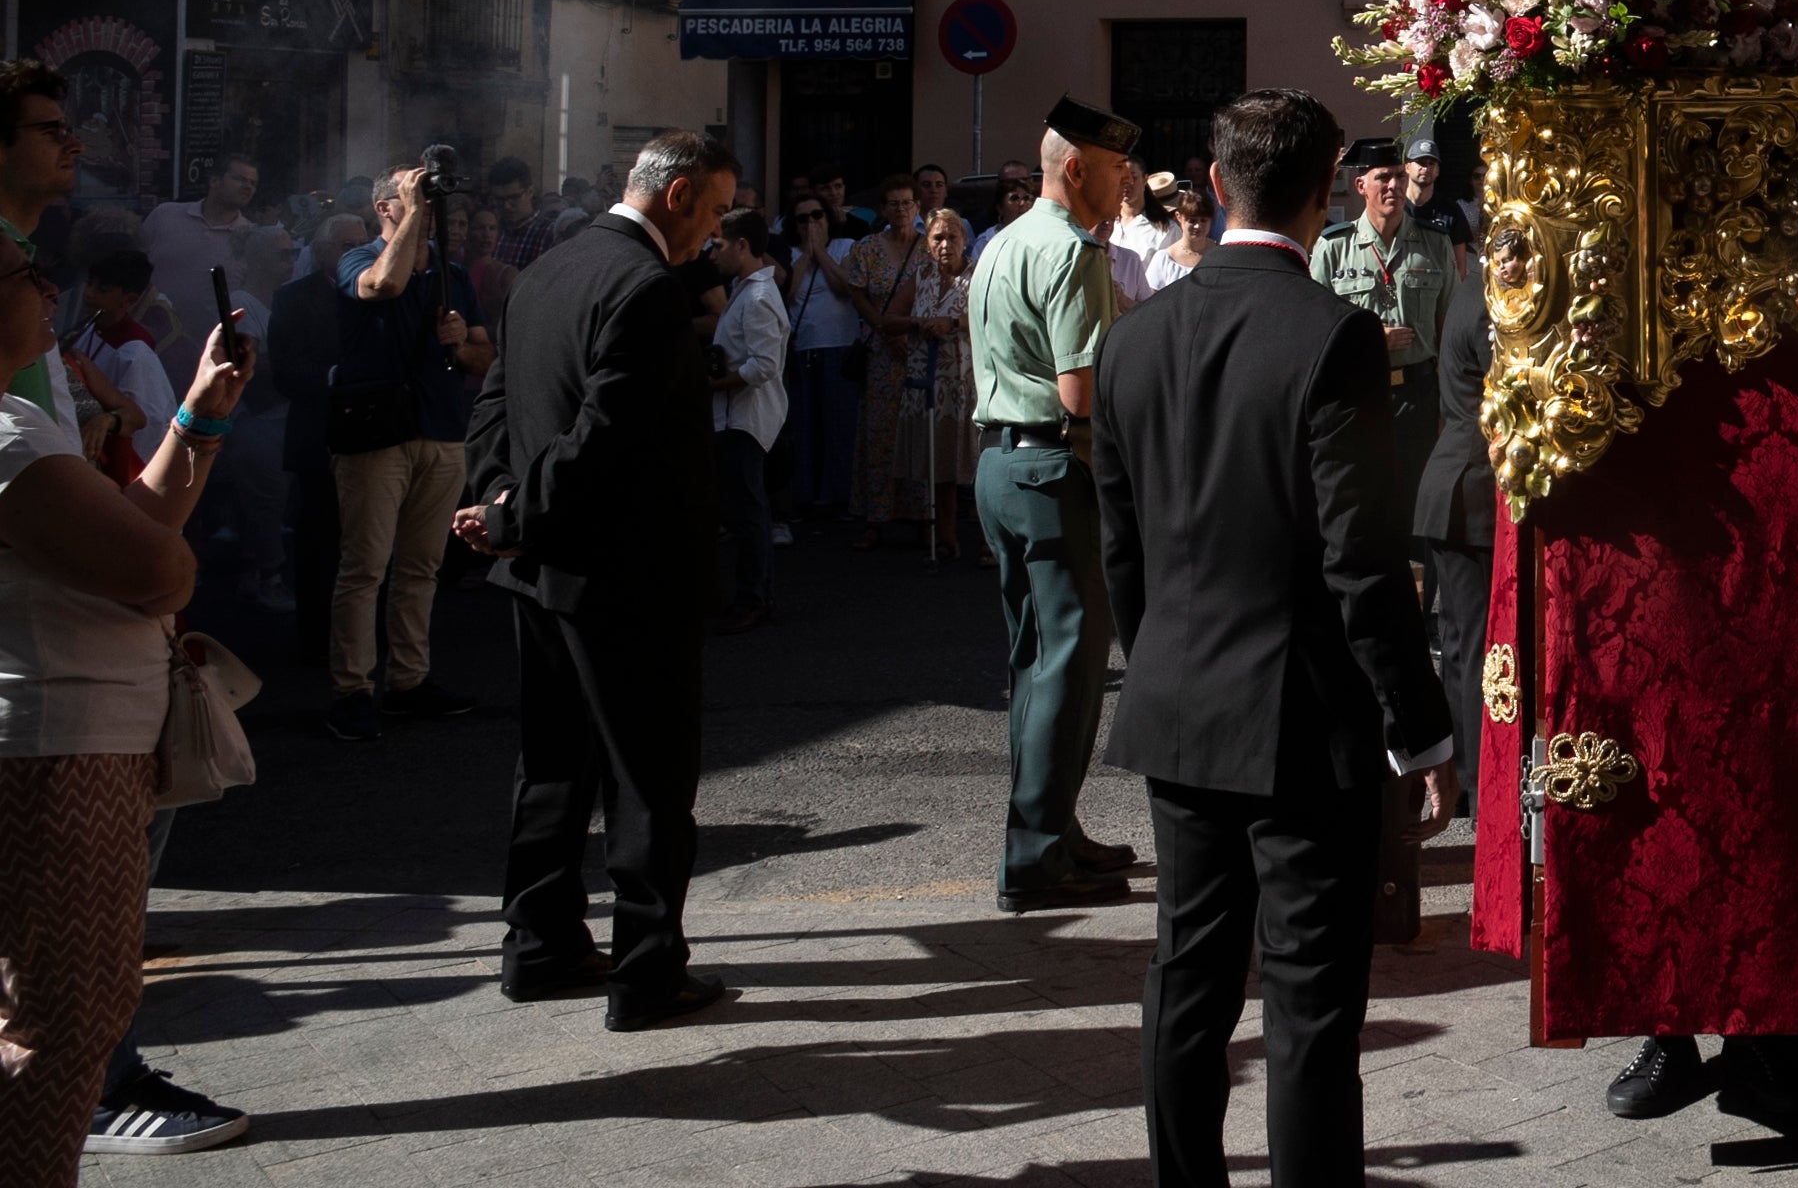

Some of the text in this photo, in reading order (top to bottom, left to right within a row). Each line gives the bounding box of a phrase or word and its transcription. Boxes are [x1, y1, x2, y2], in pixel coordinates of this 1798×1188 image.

[685, 17, 905, 35] PESCADERIA LA ALEGRIA
[778, 38, 905, 52] TLF. 954 564 738
